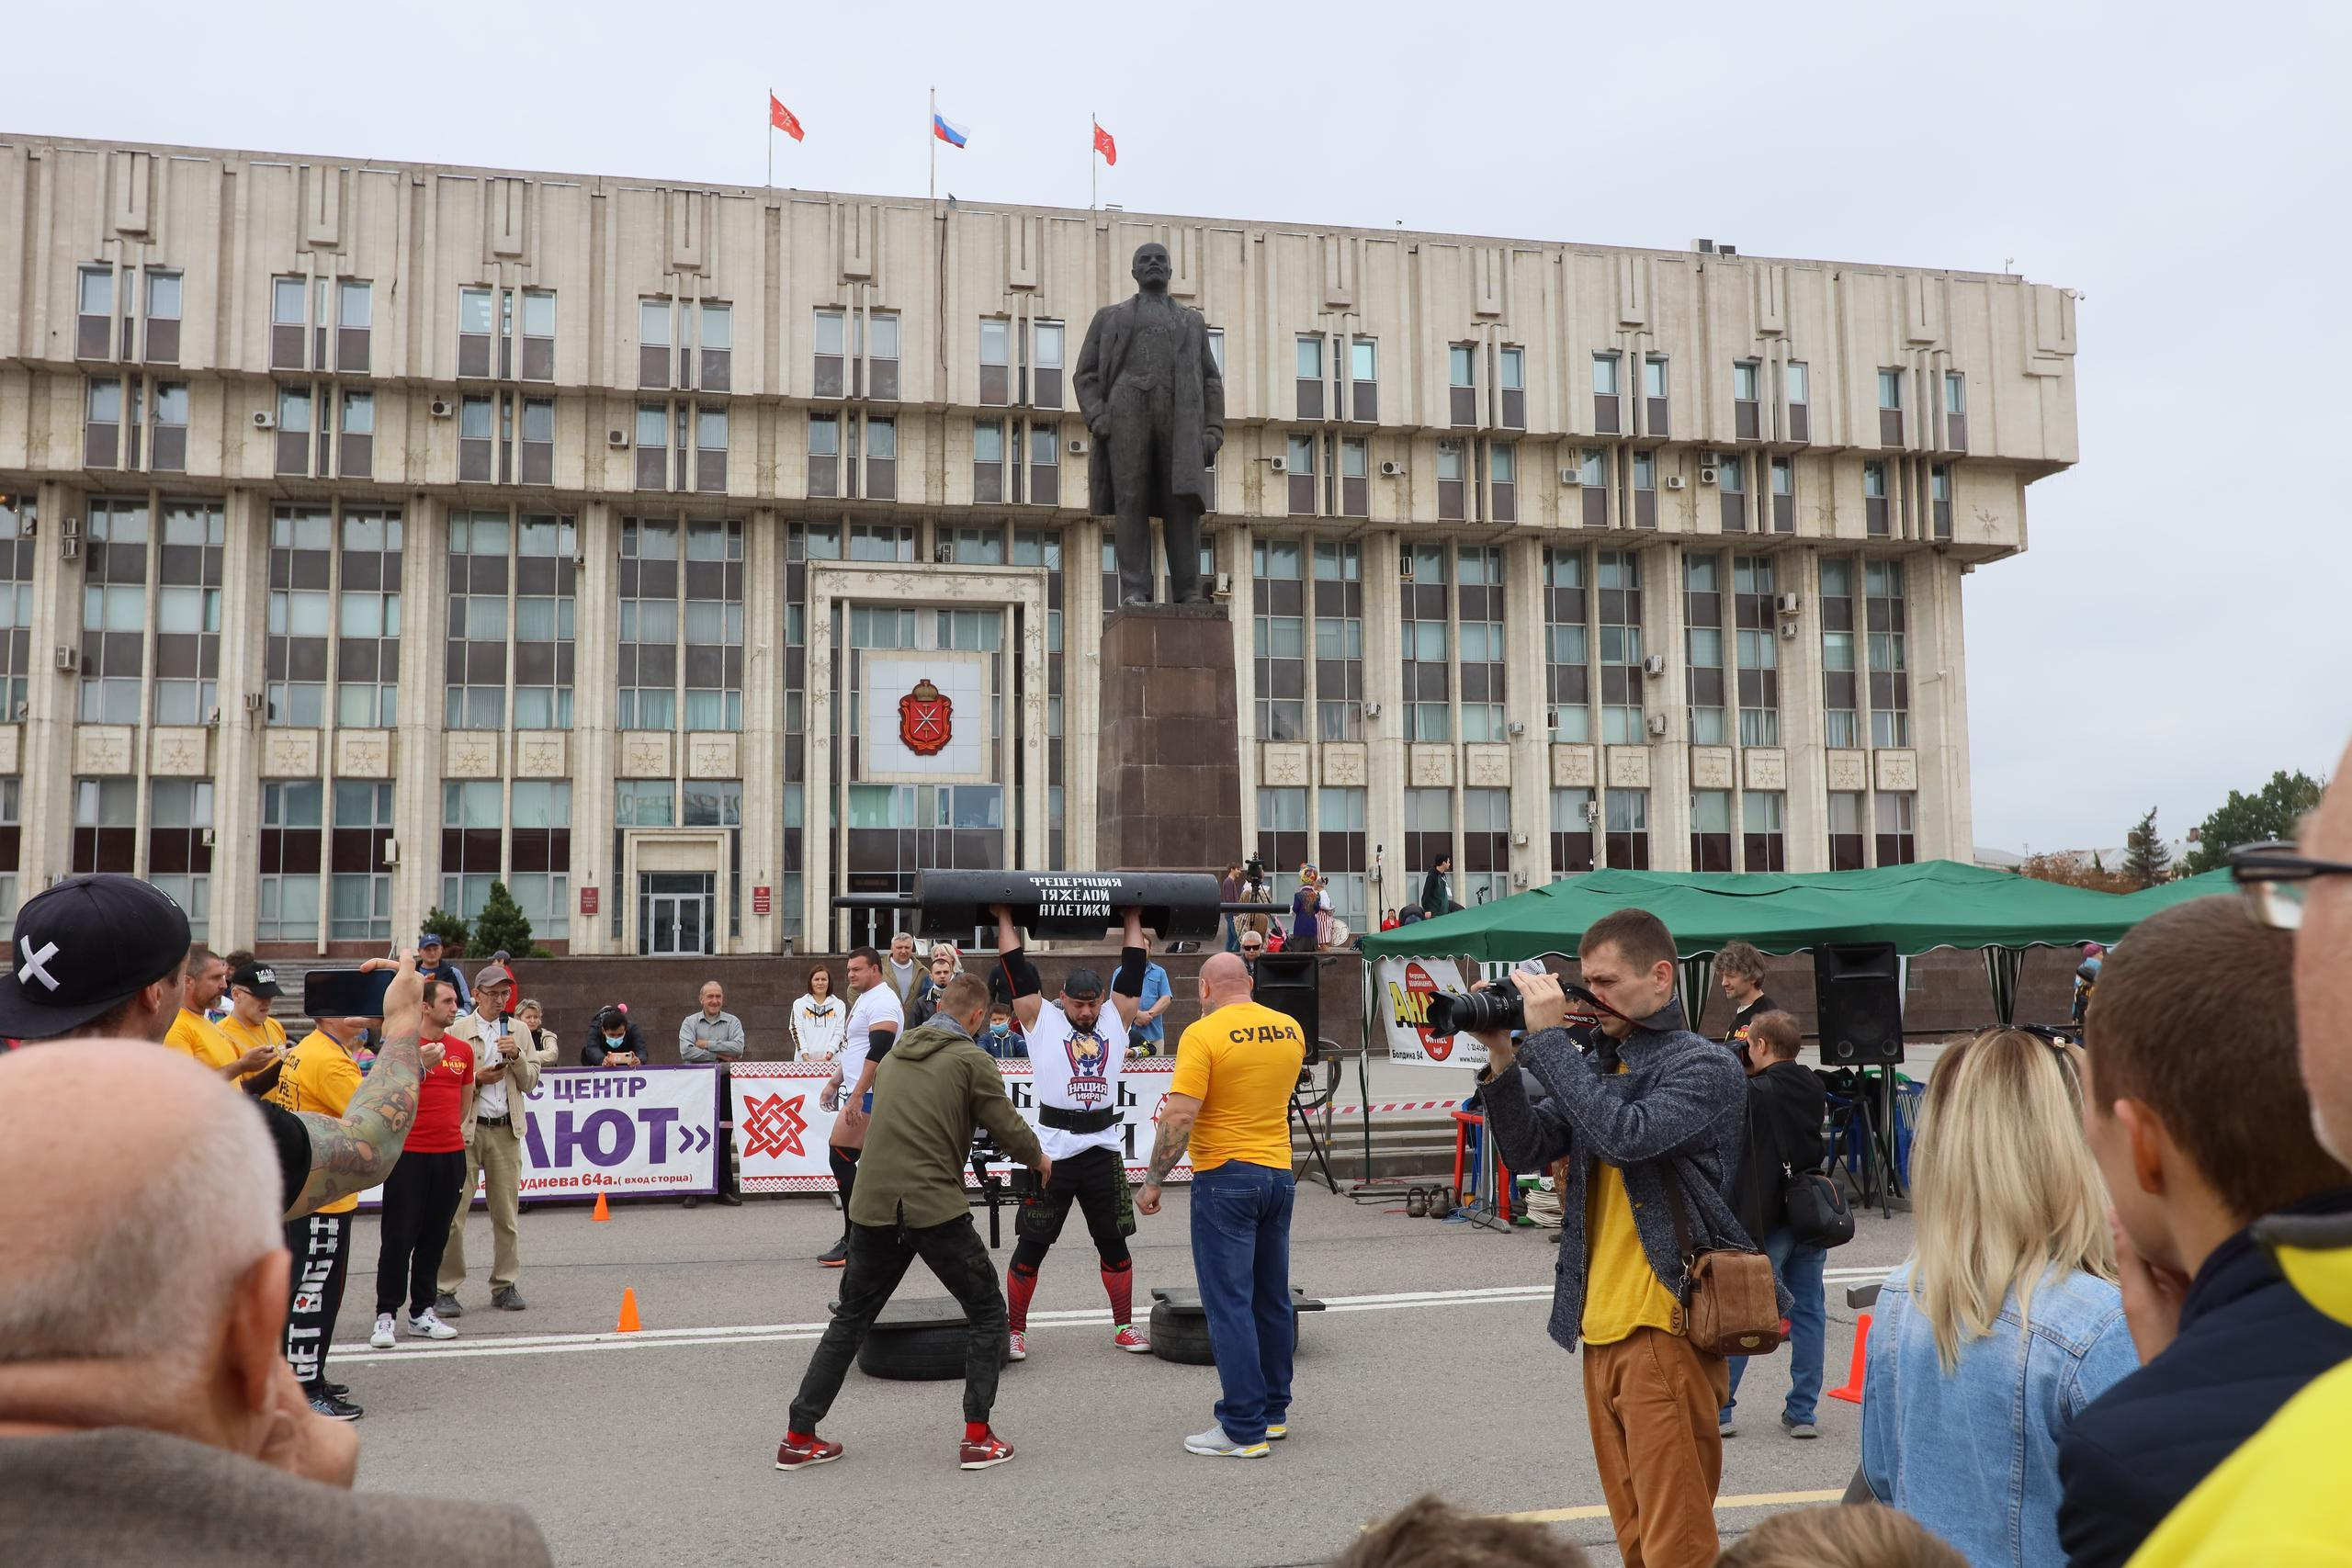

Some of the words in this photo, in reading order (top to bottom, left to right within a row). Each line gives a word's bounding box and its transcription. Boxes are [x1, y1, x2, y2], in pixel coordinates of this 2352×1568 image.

[1029, 877, 1123, 887] ФЕДЕРАЦИЯ
[1040, 887, 1110, 902] ТЯЖЁЛОЙ
[1039, 904, 1111, 917] АТЛЕТИКИ
[1229, 1025, 1297, 1043] СУДЬЯ
[1392, 1050, 1416, 1060] Болдина
[1417, 1051, 1423, 1060] 94
[553, 1077, 648, 1104] ЦЕНТР
[1069, 1083, 1107, 1094] НАЦИЯ
[519, 1177, 579, 1191] уднева
[292, 1259, 334, 1314] BIG
